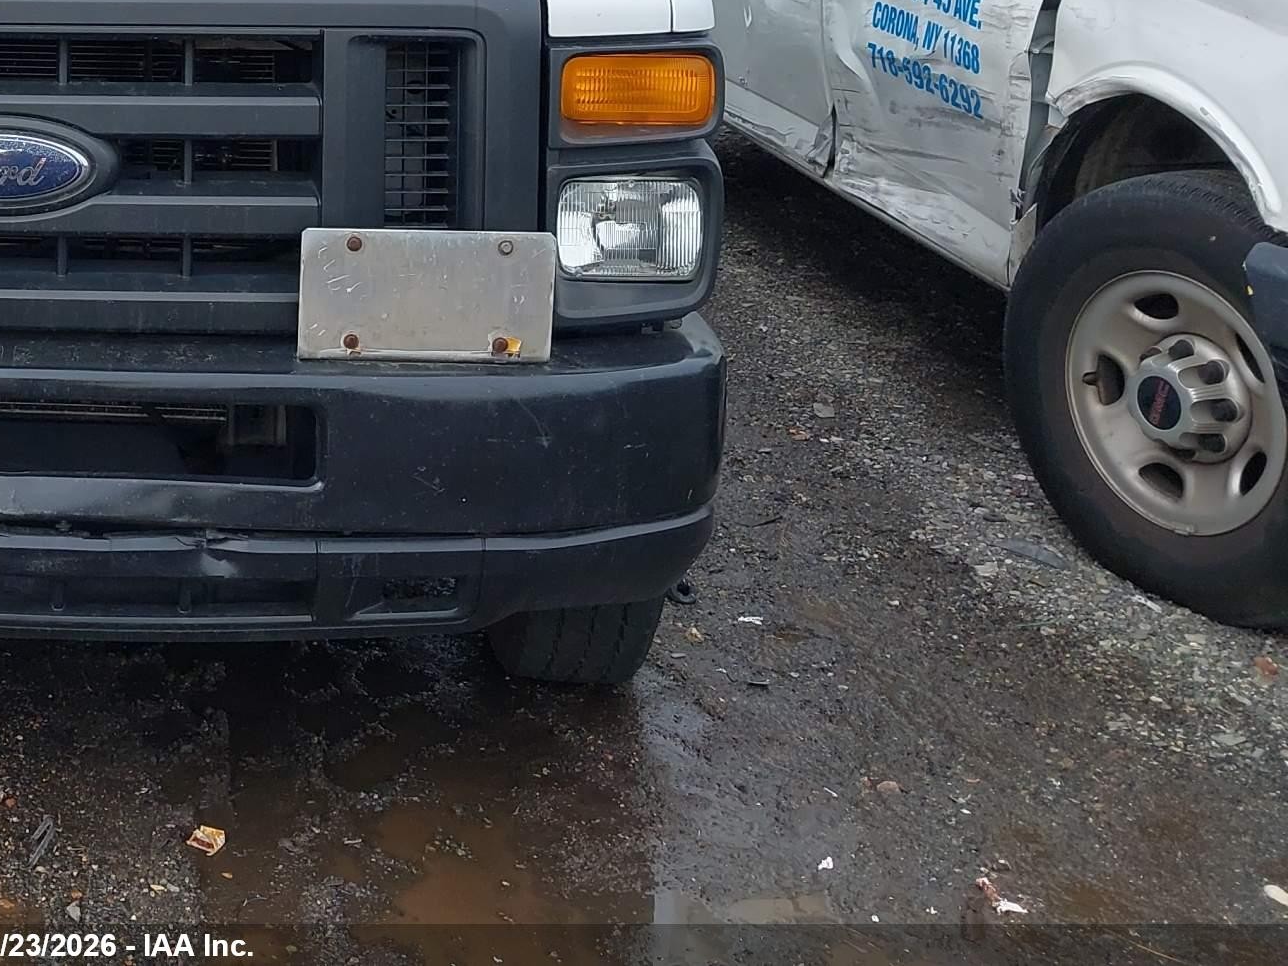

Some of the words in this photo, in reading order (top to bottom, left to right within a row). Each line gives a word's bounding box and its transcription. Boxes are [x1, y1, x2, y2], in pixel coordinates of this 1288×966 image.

[872, 1, 920, 51] CORONA,
[922, 20, 943, 51] NY
[943, 30, 981, 75] 11368
[867, 41, 984, 120] 718-592-6292
